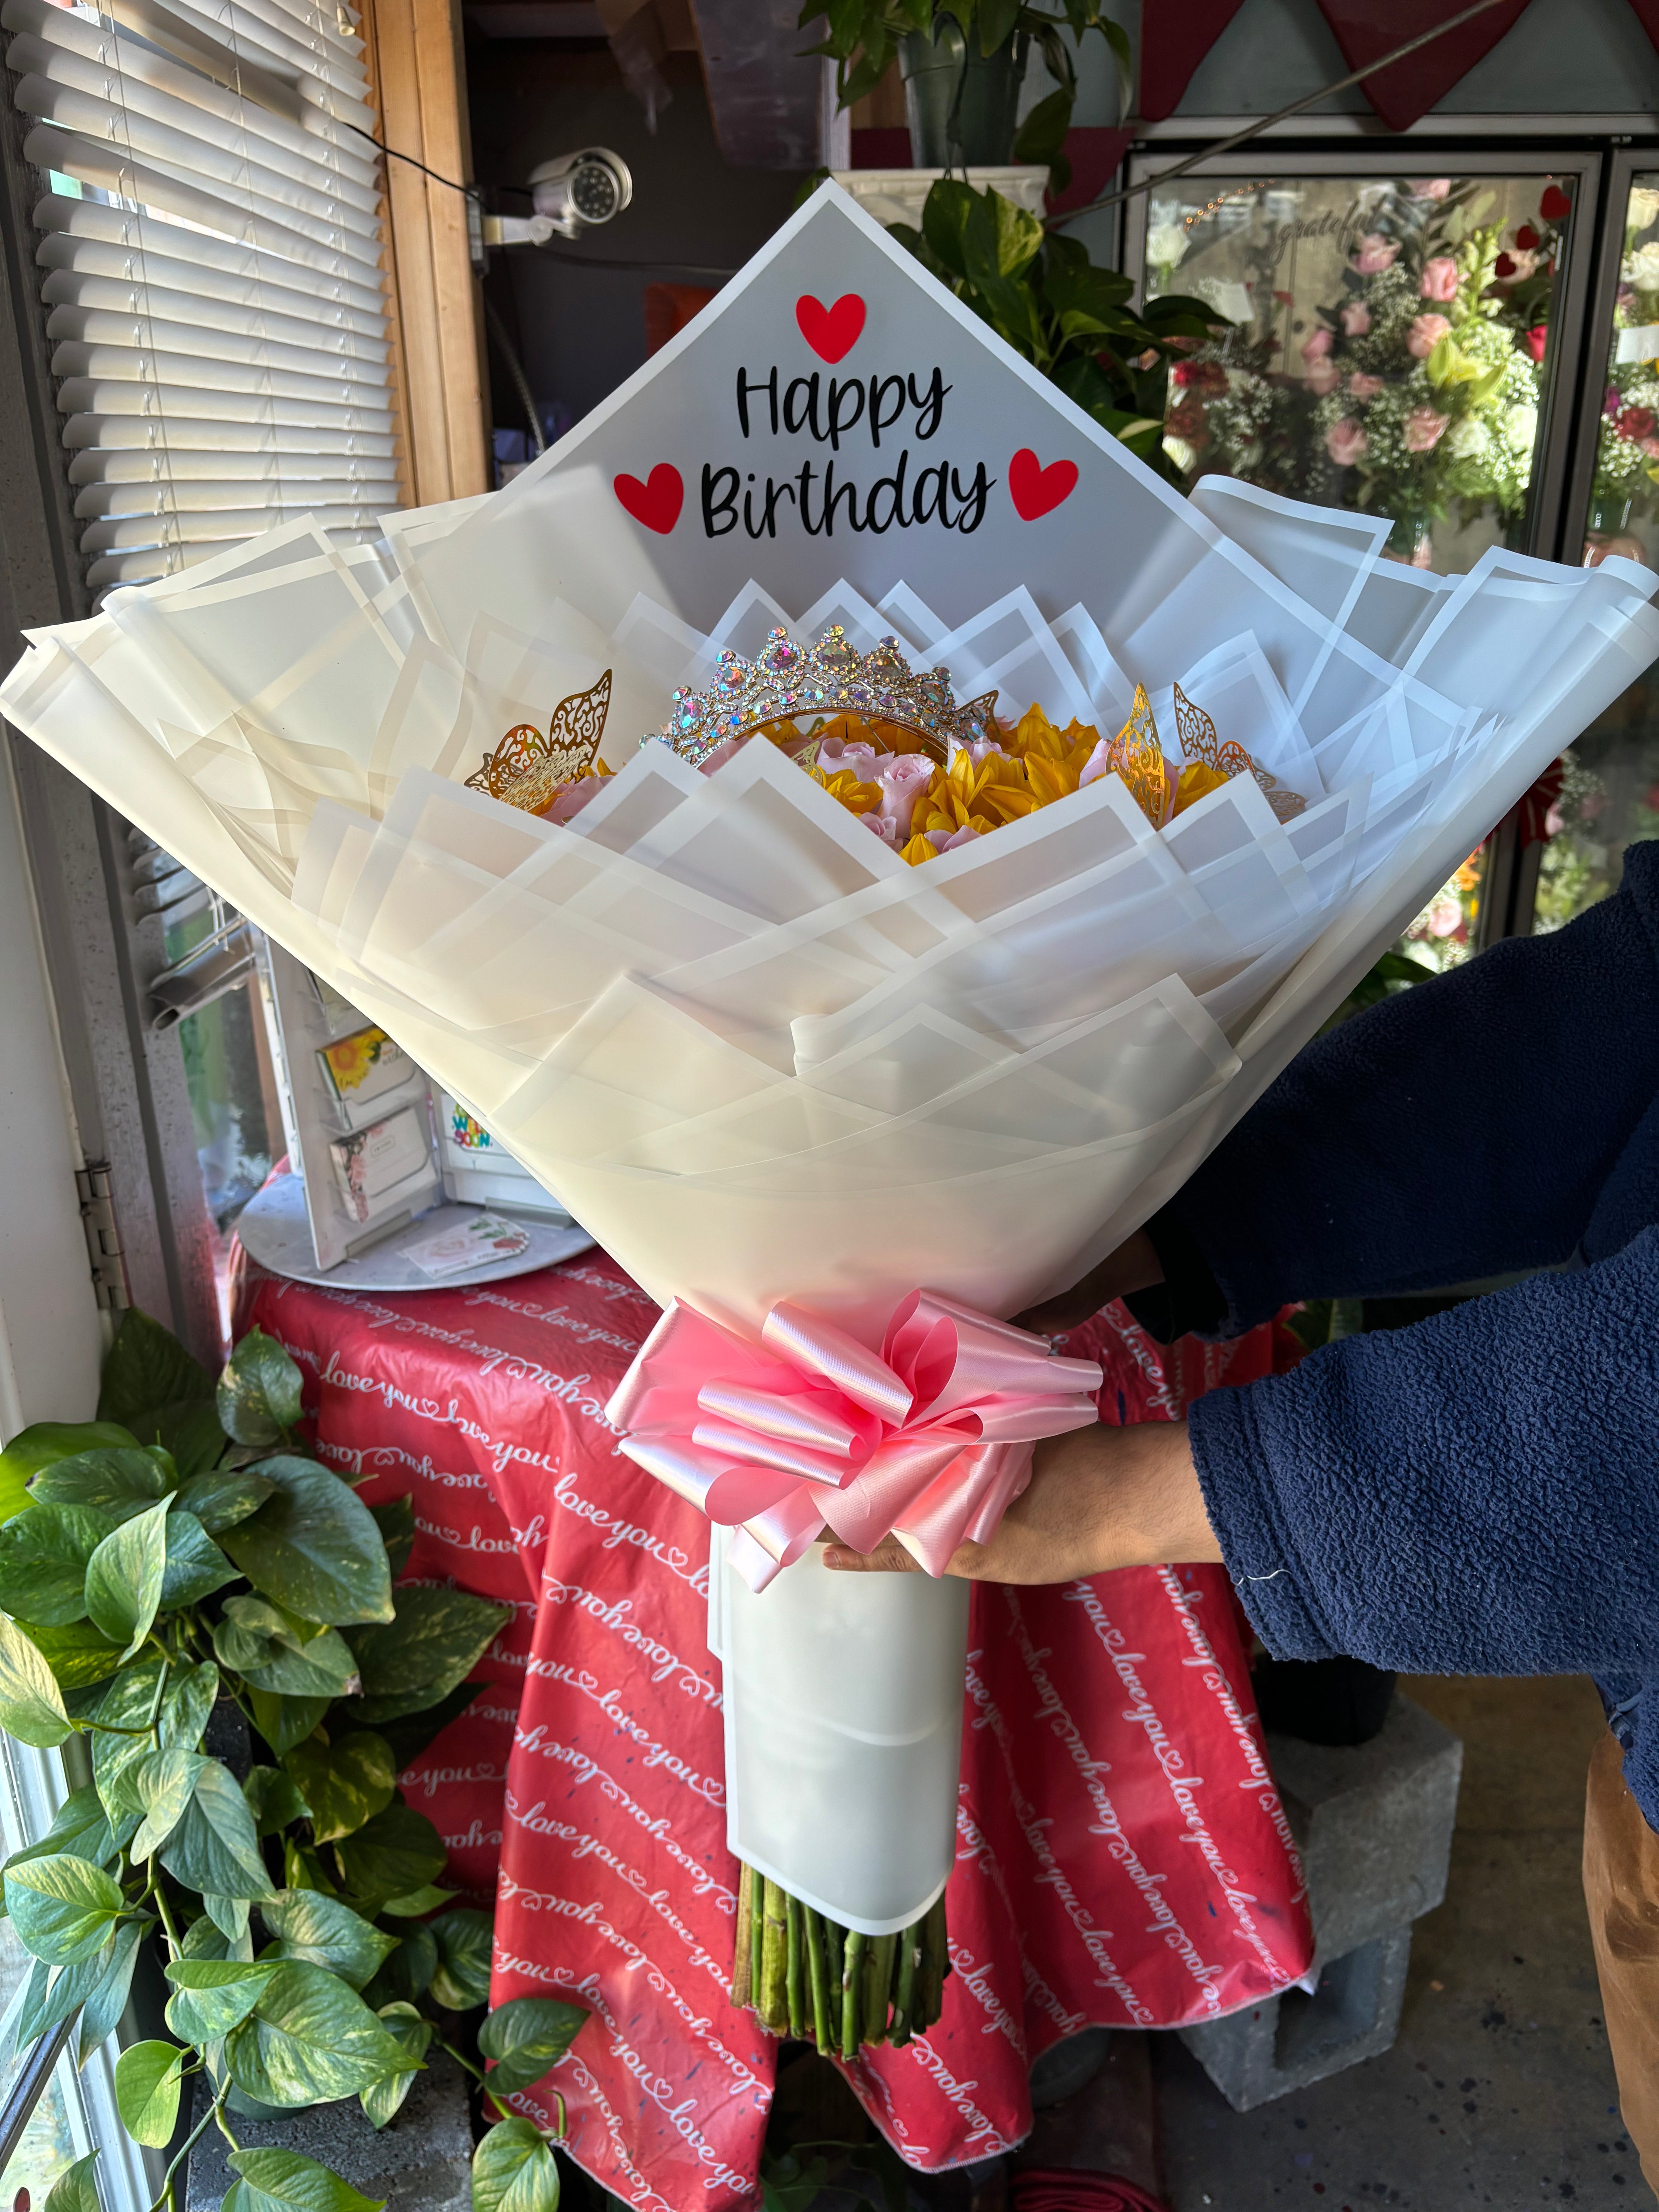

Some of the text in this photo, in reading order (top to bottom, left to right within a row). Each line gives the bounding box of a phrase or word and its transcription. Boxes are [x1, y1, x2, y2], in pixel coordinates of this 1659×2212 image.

[737, 366, 953, 451] Happy
[701, 450, 997, 539] Birthday
[454, 1129, 490, 1147] SOON
